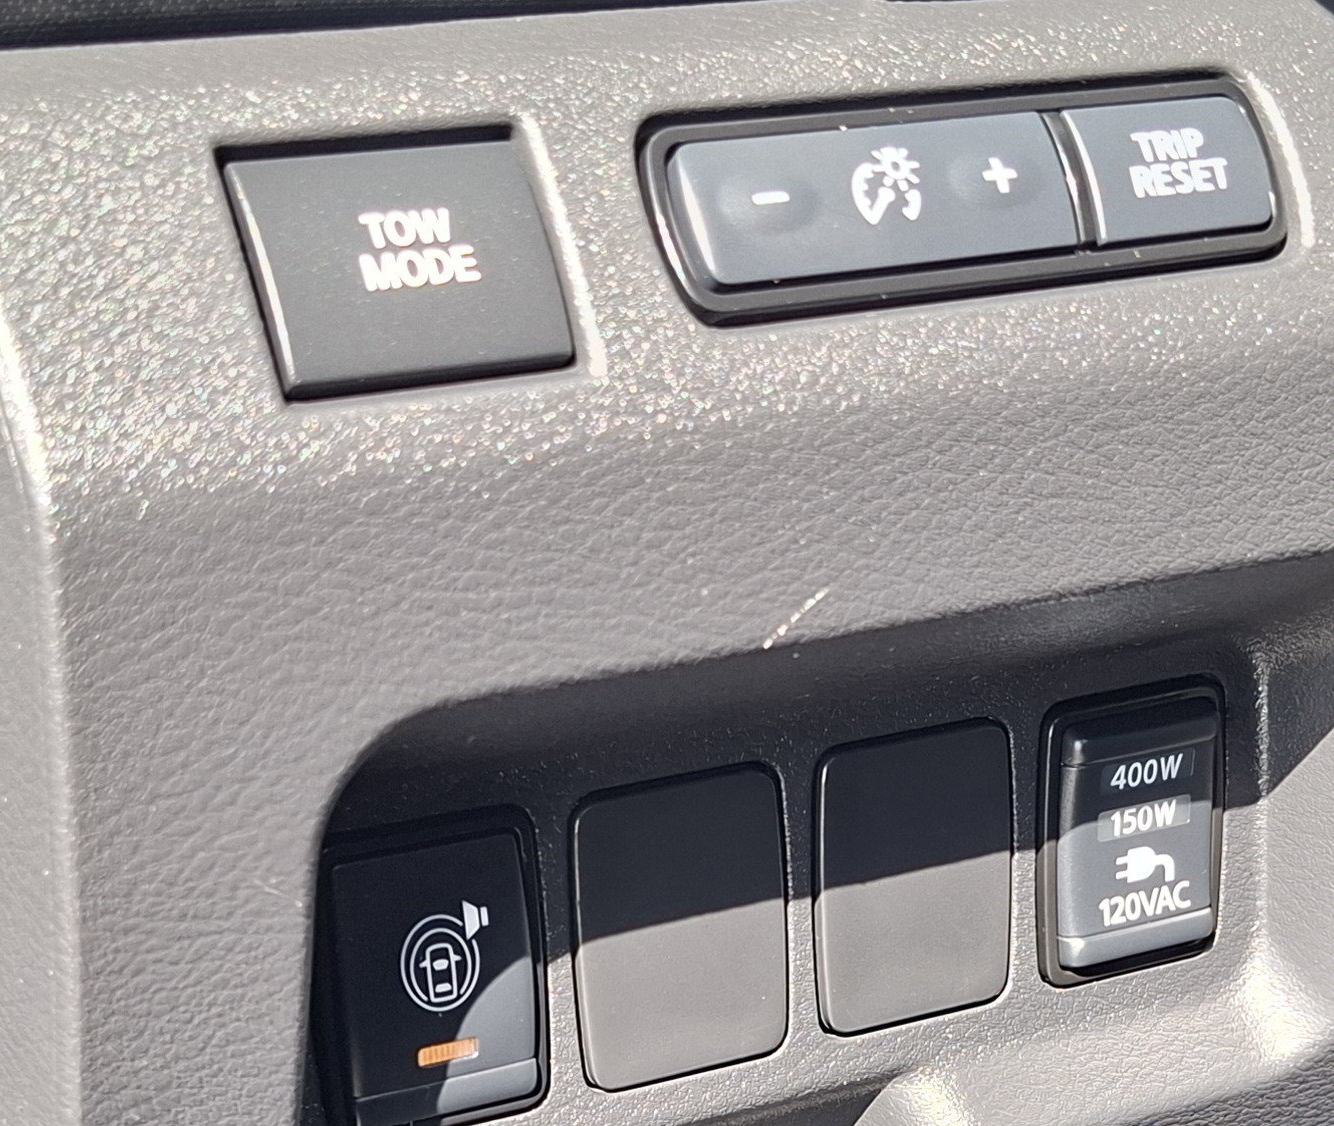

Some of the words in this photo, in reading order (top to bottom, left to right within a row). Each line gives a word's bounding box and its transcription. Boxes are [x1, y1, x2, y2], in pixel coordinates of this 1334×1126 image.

[1129, 126, 1205, 163] TRIP
[1128, 157, 1228, 199] RESET
[357, 207, 452, 250] TOW
[358, 243, 483, 292] MODE
[1110, 752, 1184, 790] 400W
[1110, 798, 1177, 838] 150W
[1098, 879, 1192, 928] 120VAC
